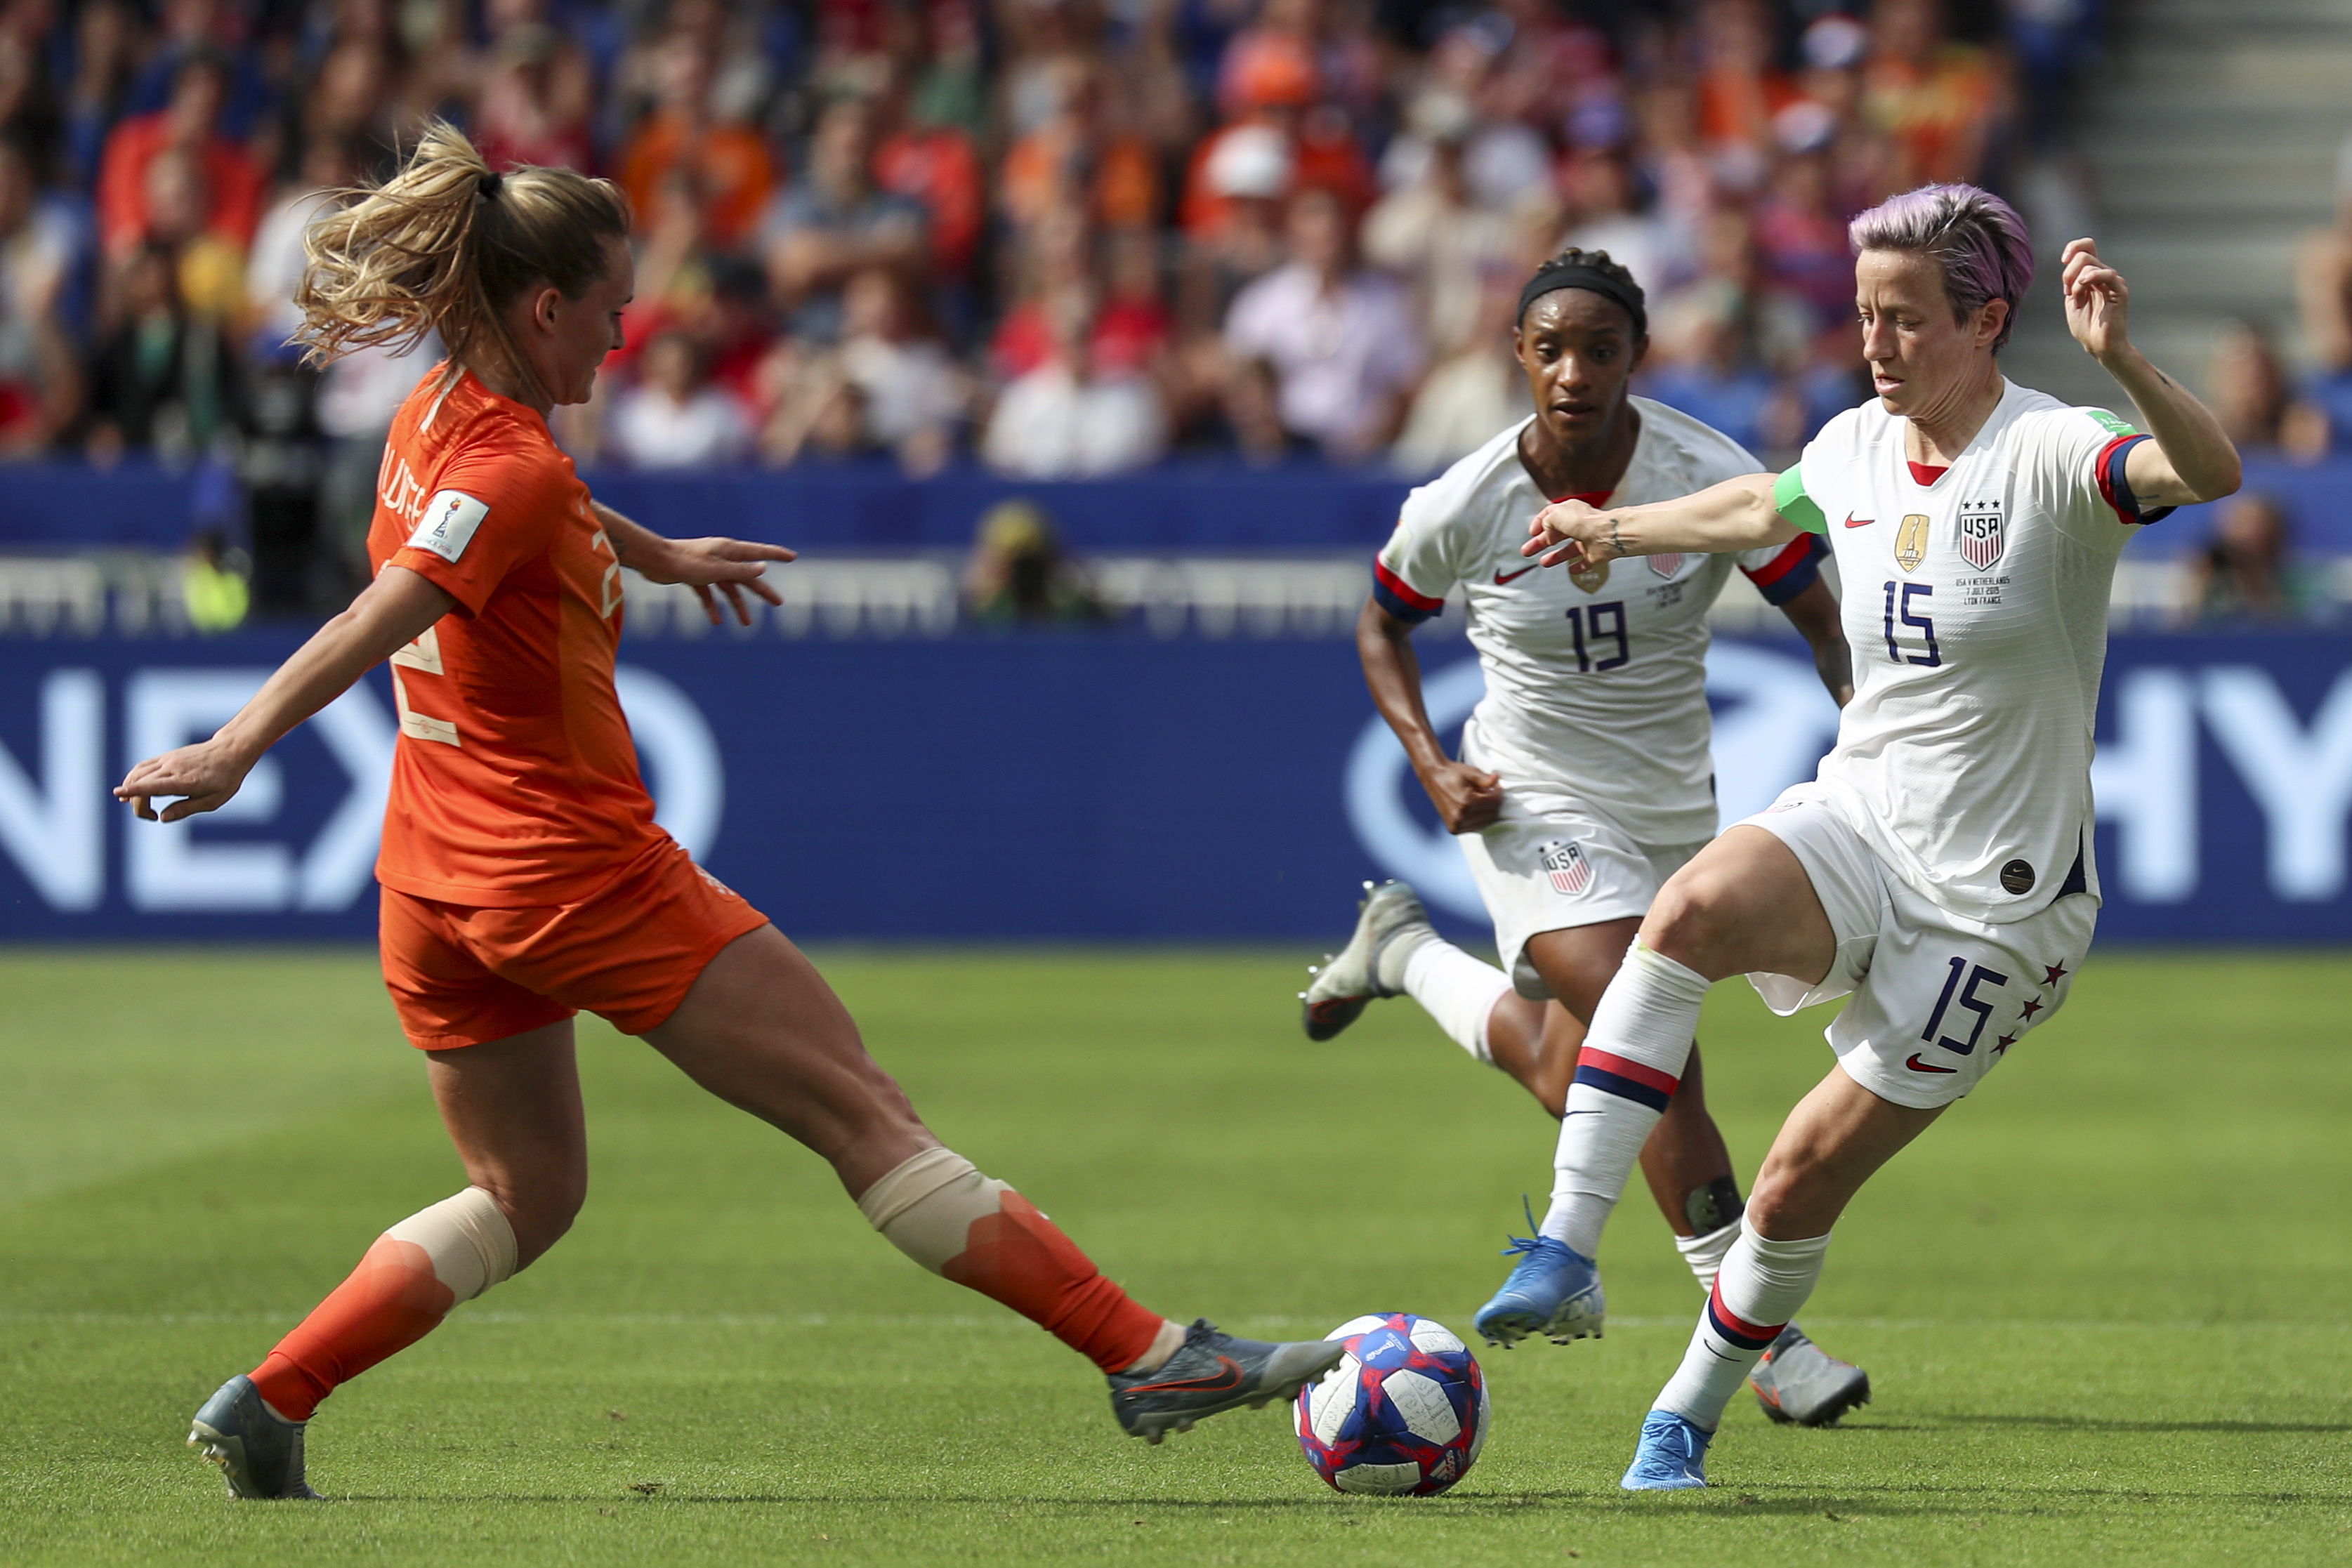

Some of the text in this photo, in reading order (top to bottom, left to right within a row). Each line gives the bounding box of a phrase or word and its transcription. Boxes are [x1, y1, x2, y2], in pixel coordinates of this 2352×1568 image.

[1964, 518, 1999, 539] USA
[1902, 549, 1919, 558] FIFA
[1566, 600, 1629, 673] 19
[1884, 580, 1942, 666] 15
[1546, 846, 1579, 871] USA
[1921, 956, 2009, 1056] 15
